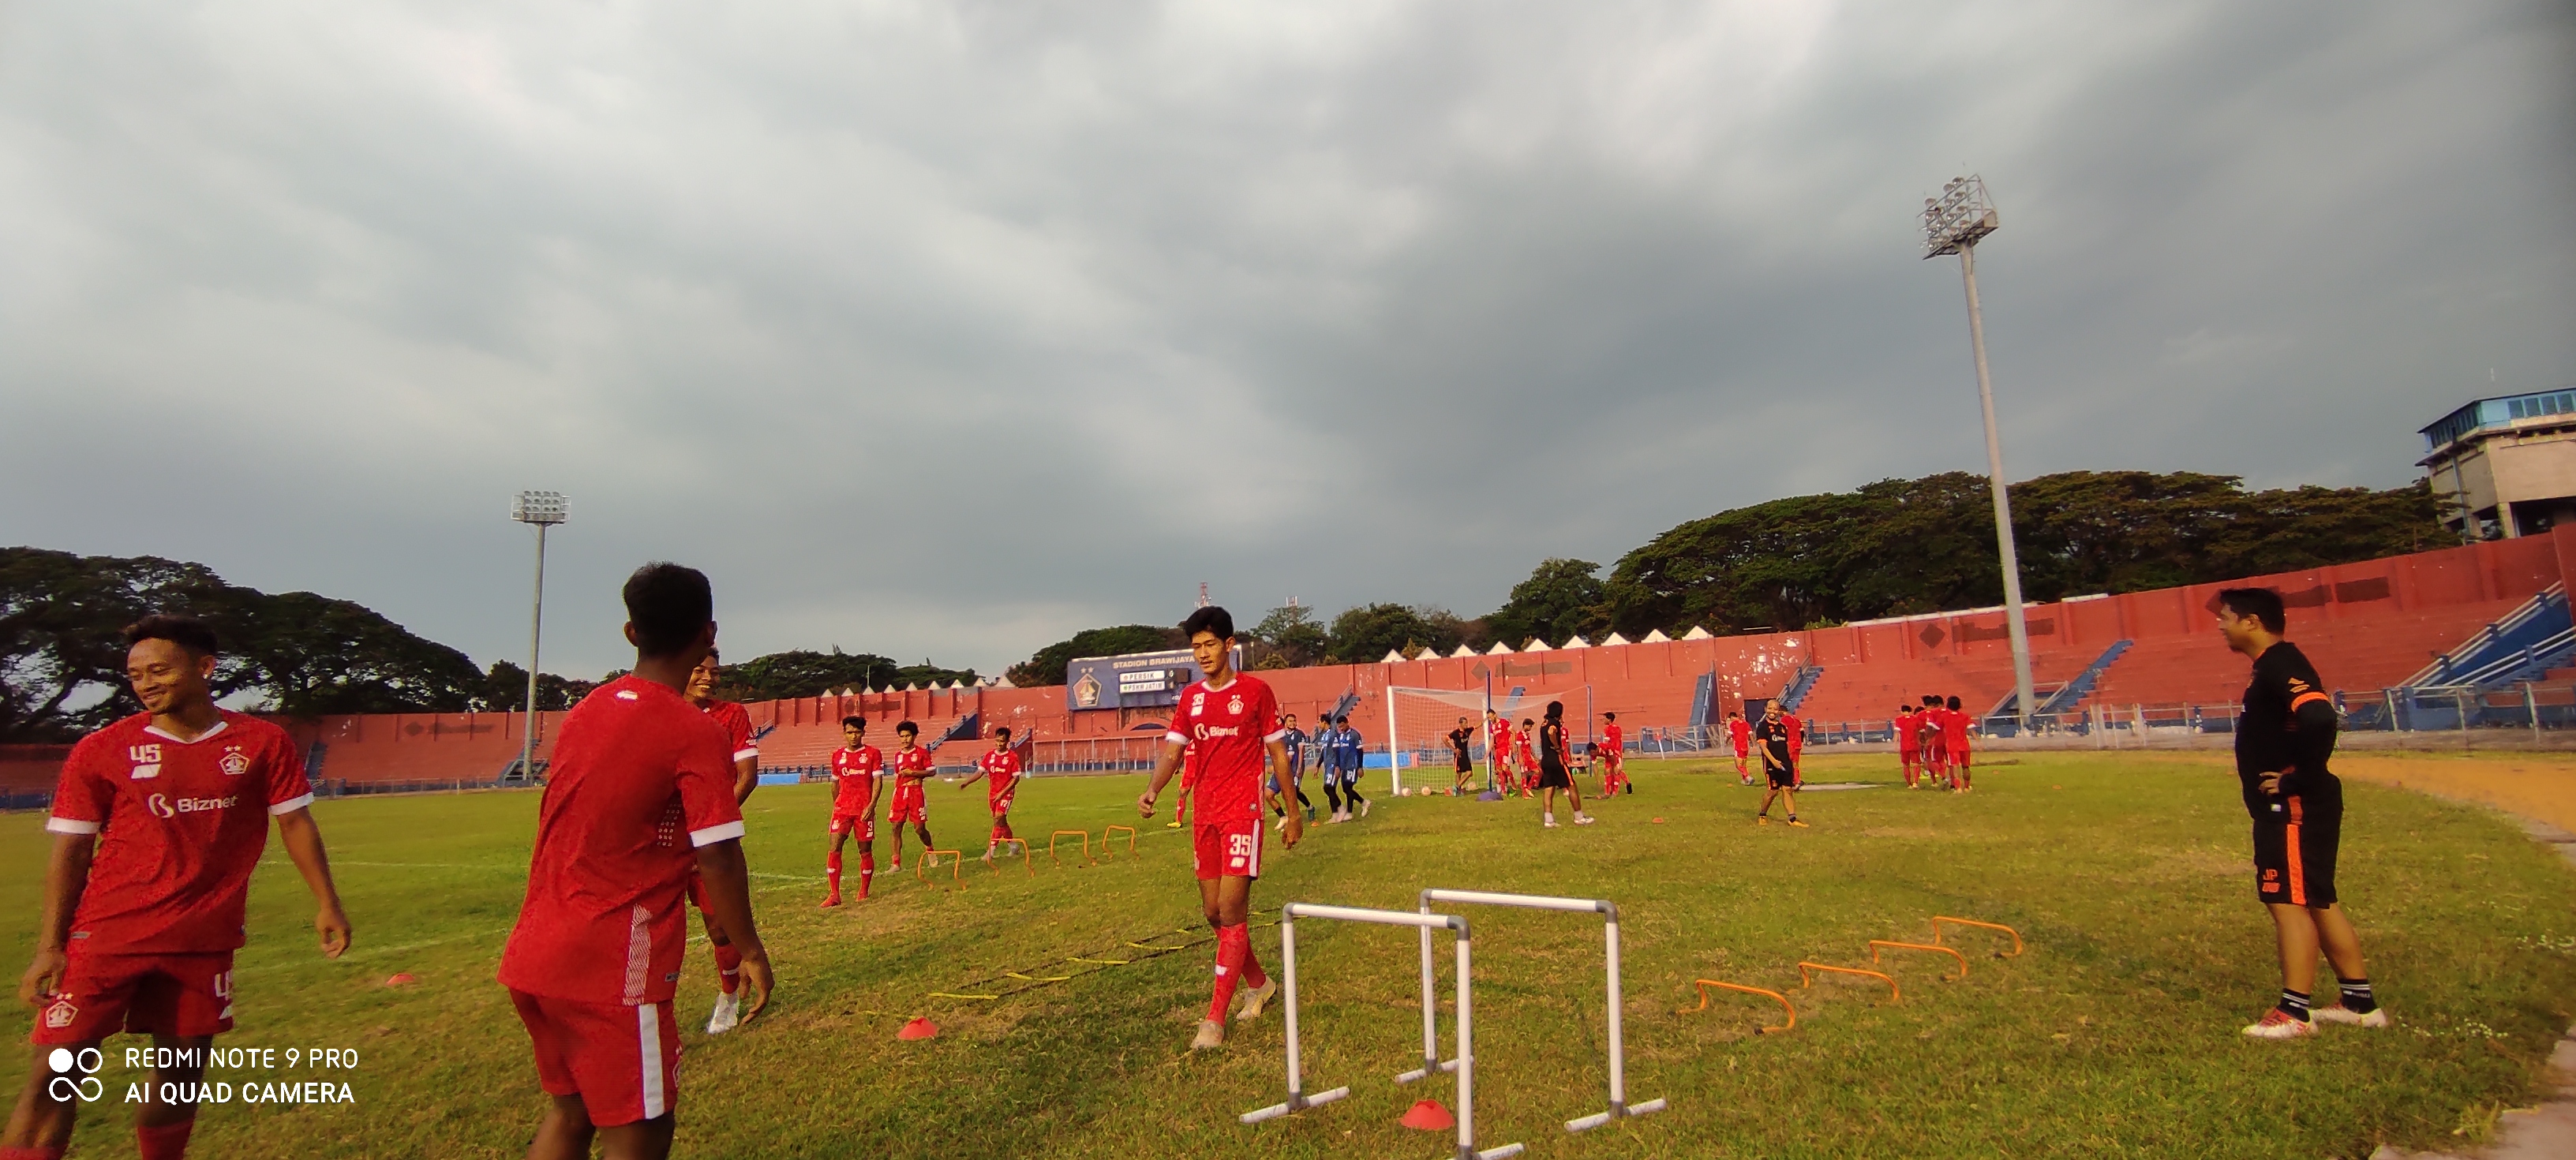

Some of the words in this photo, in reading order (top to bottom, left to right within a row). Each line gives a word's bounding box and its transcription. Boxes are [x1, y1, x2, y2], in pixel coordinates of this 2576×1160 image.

[1113, 659, 1148, 669] STADION
[1149, 656, 1195, 665] BRAWIJAYA
[1129, 672, 1154, 680] PERSIK
[1209, 725, 1239, 737] Biznet
[129, 743, 162, 763] 45
[178, 793, 238, 813] Biznet
[2263, 869, 2278, 881] JP
